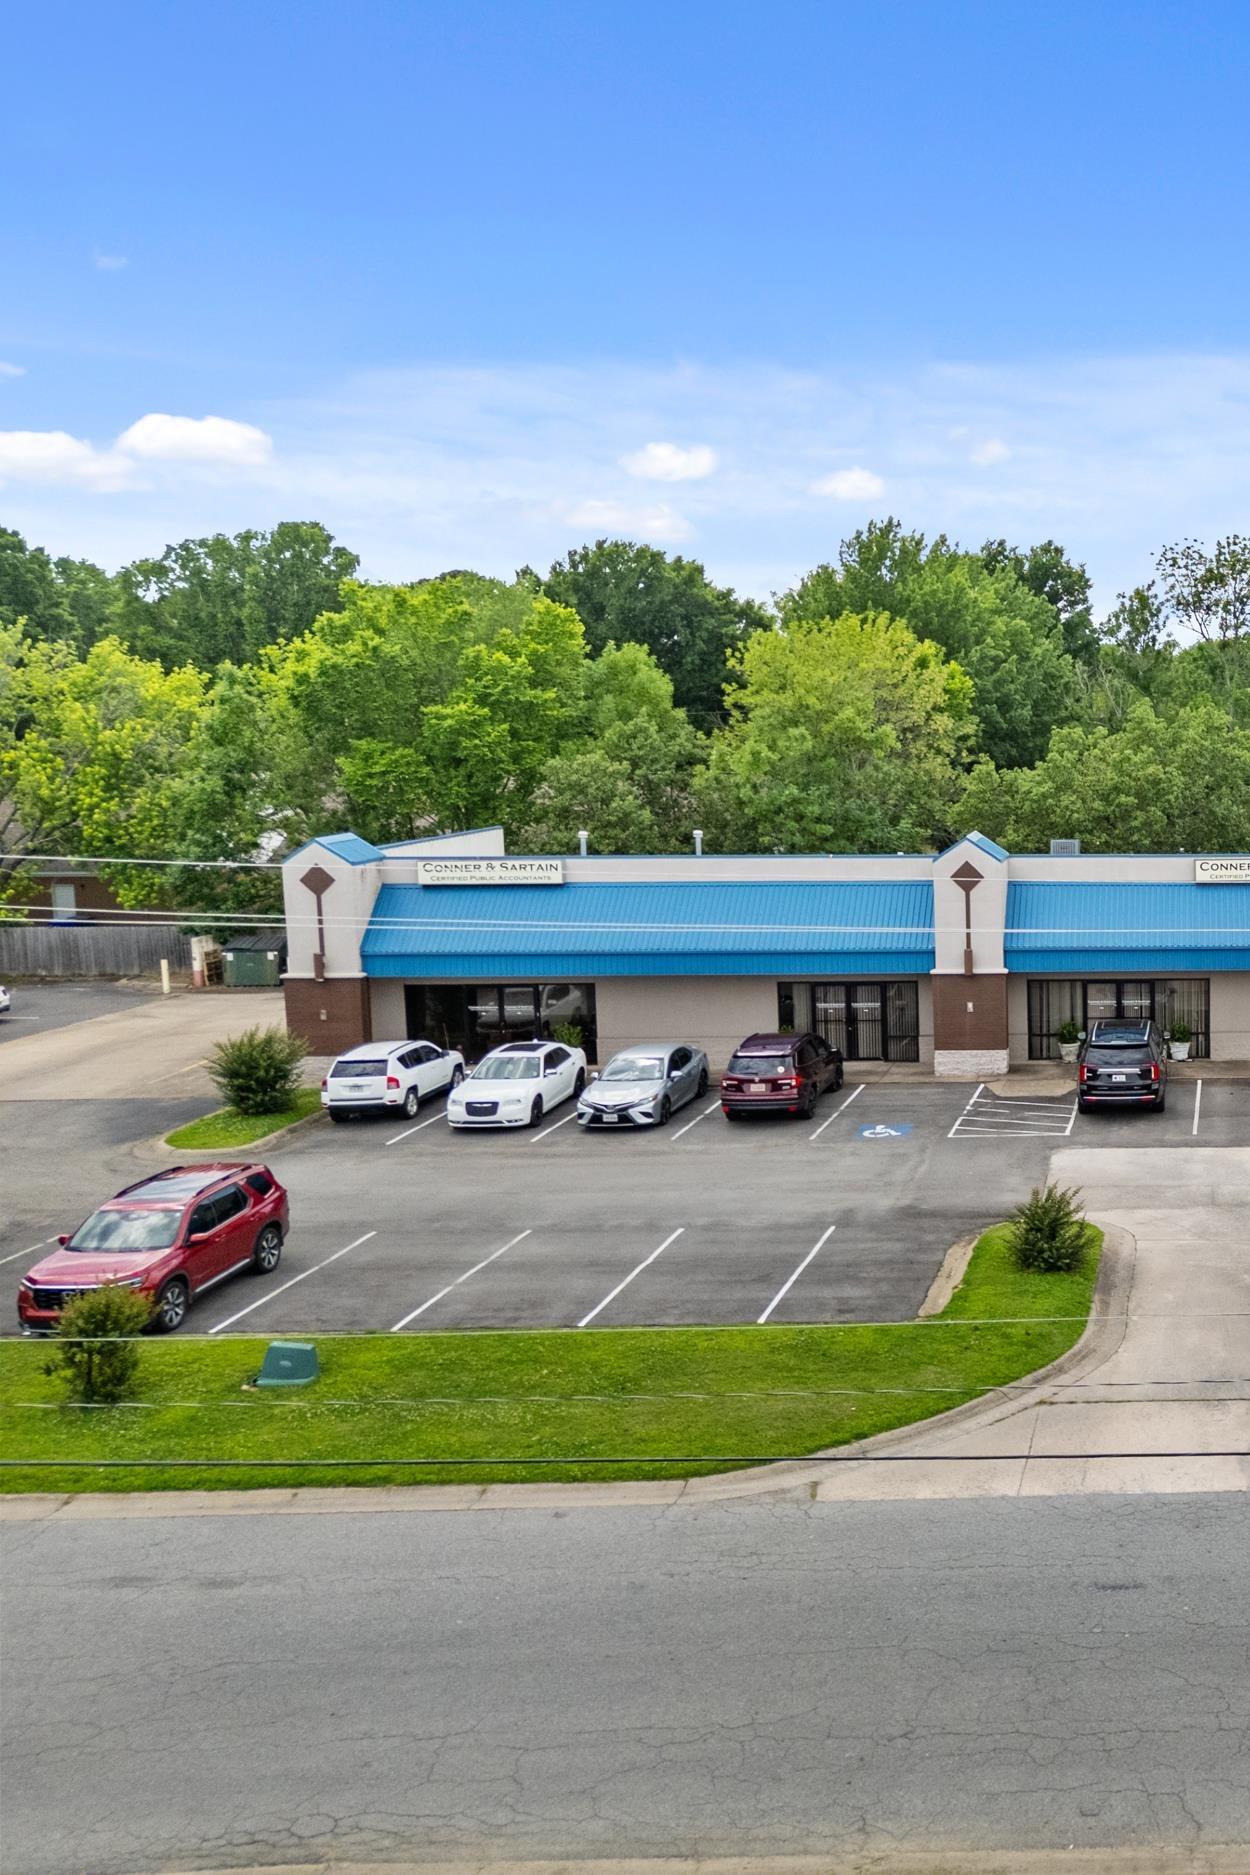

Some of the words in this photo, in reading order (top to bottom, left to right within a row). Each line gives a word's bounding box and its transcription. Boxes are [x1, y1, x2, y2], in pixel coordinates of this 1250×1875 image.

[423, 863, 481, 873] CONNER
[485, 862, 496, 872] &
[500, 862, 559, 872] SARTAIN
